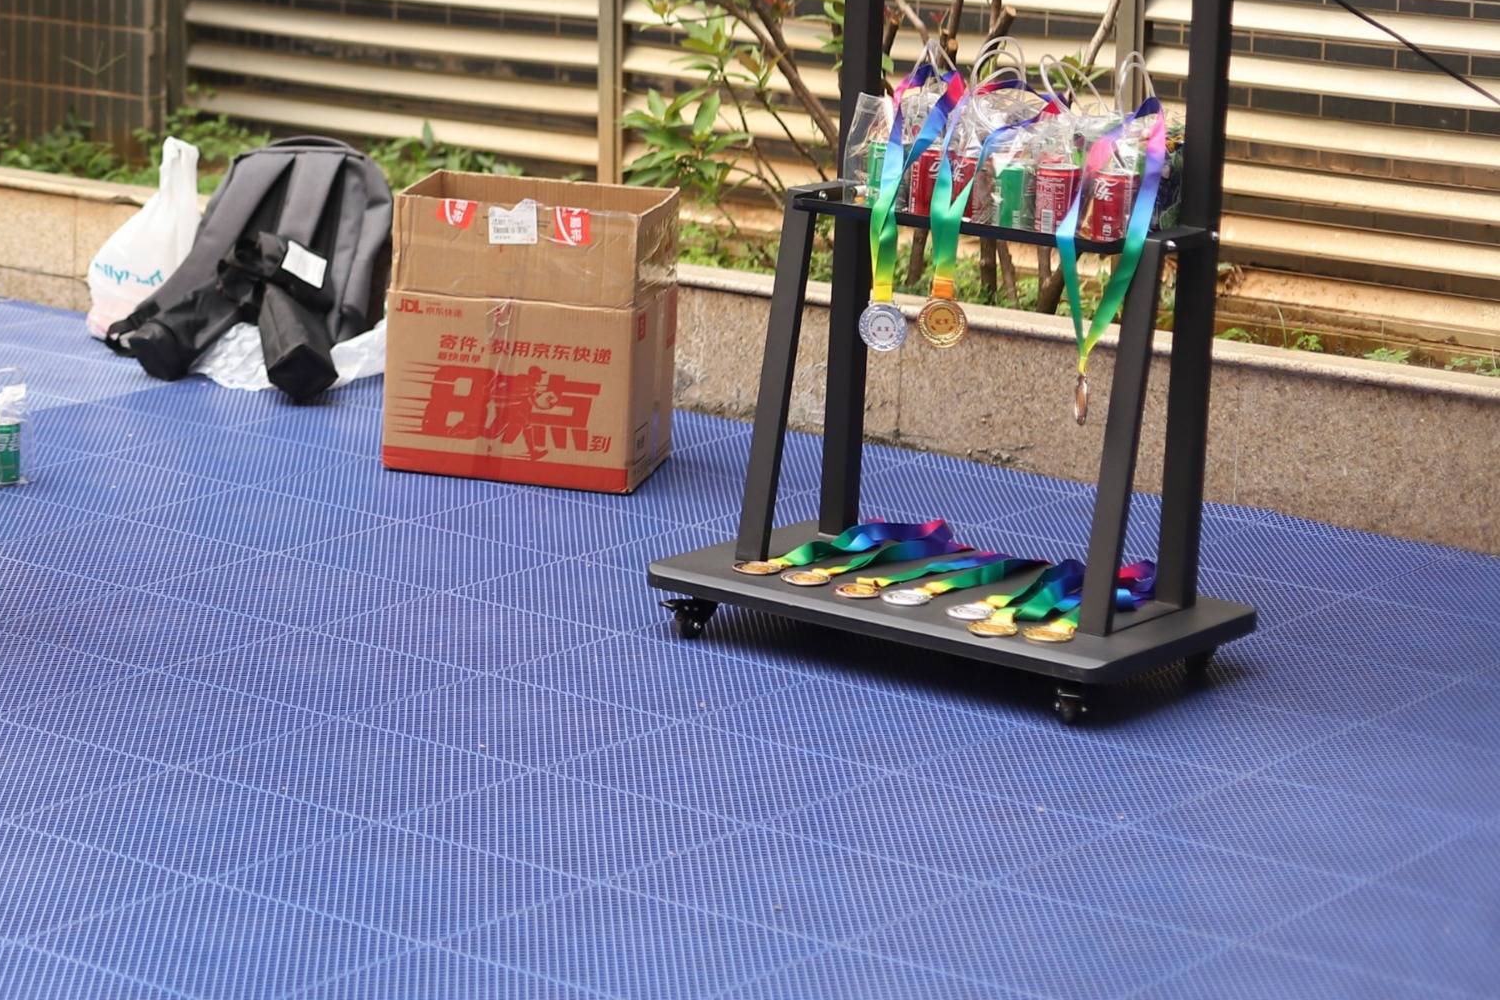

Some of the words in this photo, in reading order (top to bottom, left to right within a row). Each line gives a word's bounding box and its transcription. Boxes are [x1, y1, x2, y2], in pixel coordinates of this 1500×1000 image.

[396, 298, 423, 315] JDL
[425, 306, 463, 318] 京东快递
